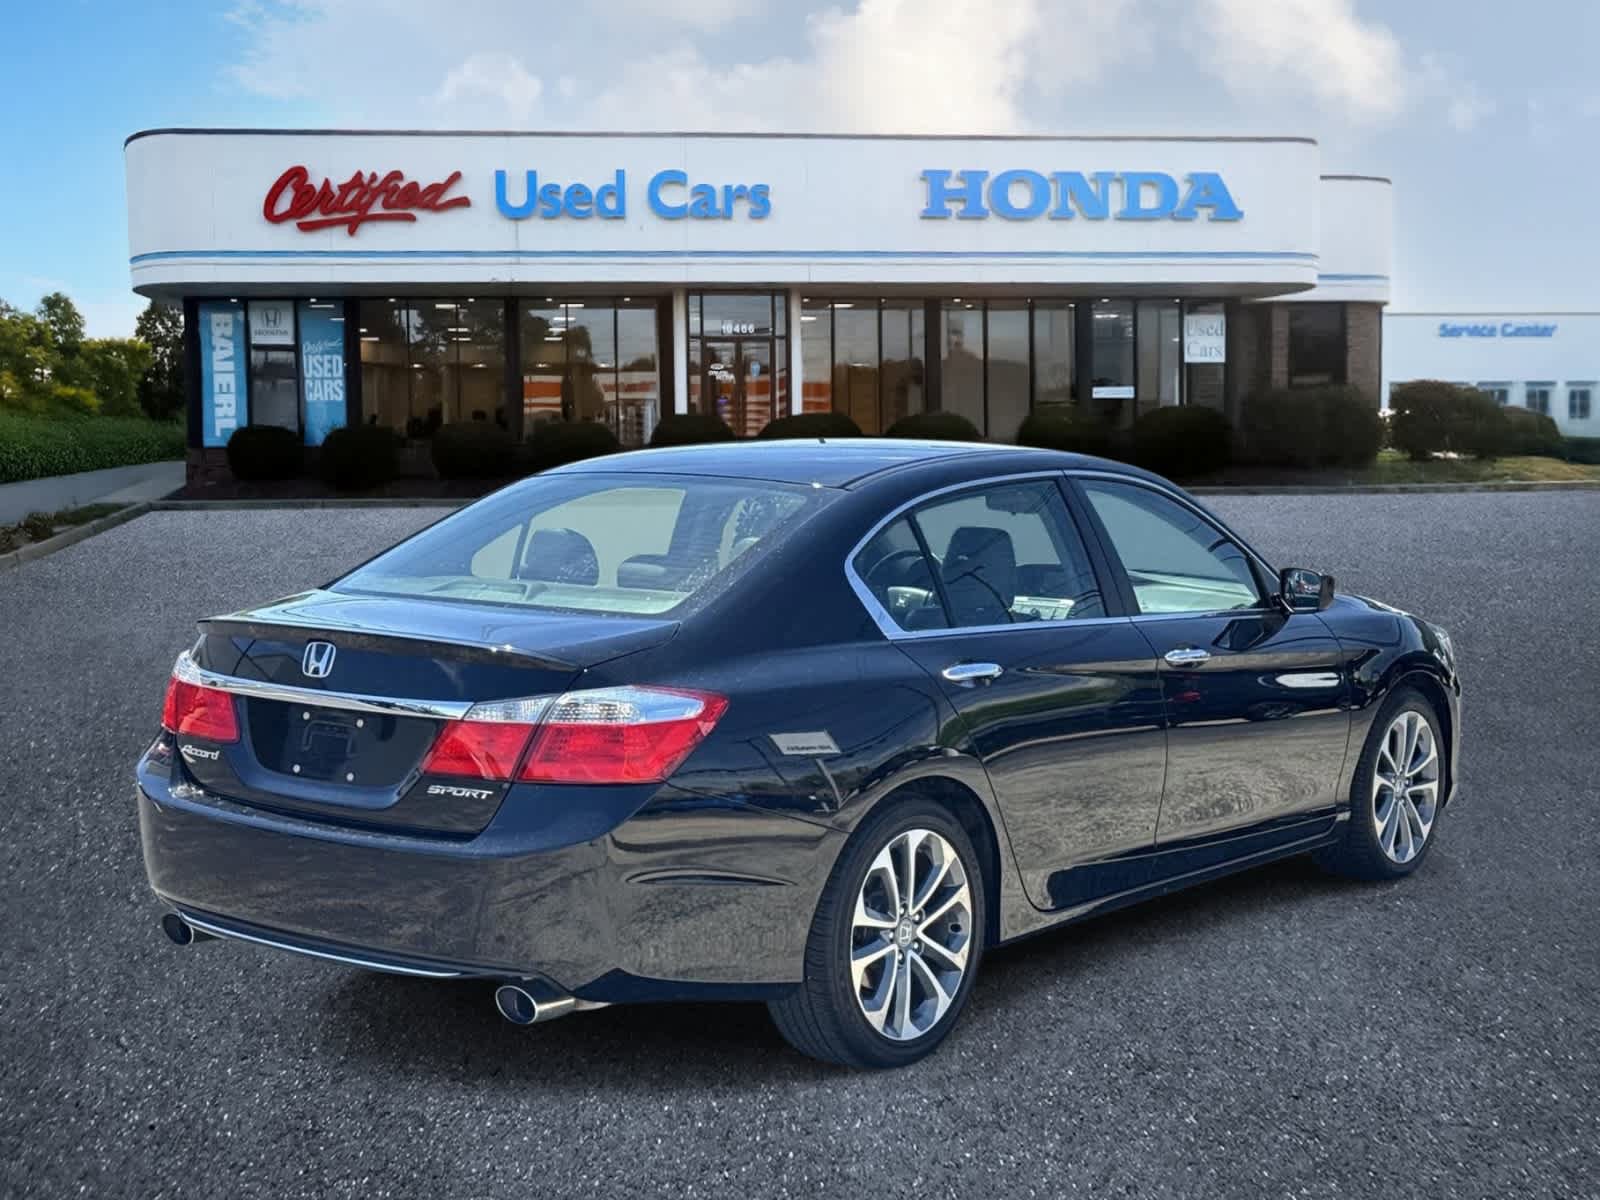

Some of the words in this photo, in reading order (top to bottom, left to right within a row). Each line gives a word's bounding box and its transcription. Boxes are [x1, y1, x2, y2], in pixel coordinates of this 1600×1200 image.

[263, 166, 472, 236] Certified
[495, 169, 626, 220] Used
[647, 170, 772, 220] Cars
[920, 169, 1244, 221] HONDA
[1187, 319, 1224, 337] Used
[1439, 323, 1497, 338] Service
[1501, 323, 1557, 338] Center
[1187, 341, 1223, 358] Cars
[211, 313, 237, 437] BAIERL
[303, 354, 342, 378] USED
[304, 379, 344, 401] CARS
[181, 744, 220, 760] Accord
[426, 784, 494, 800] SPORT
